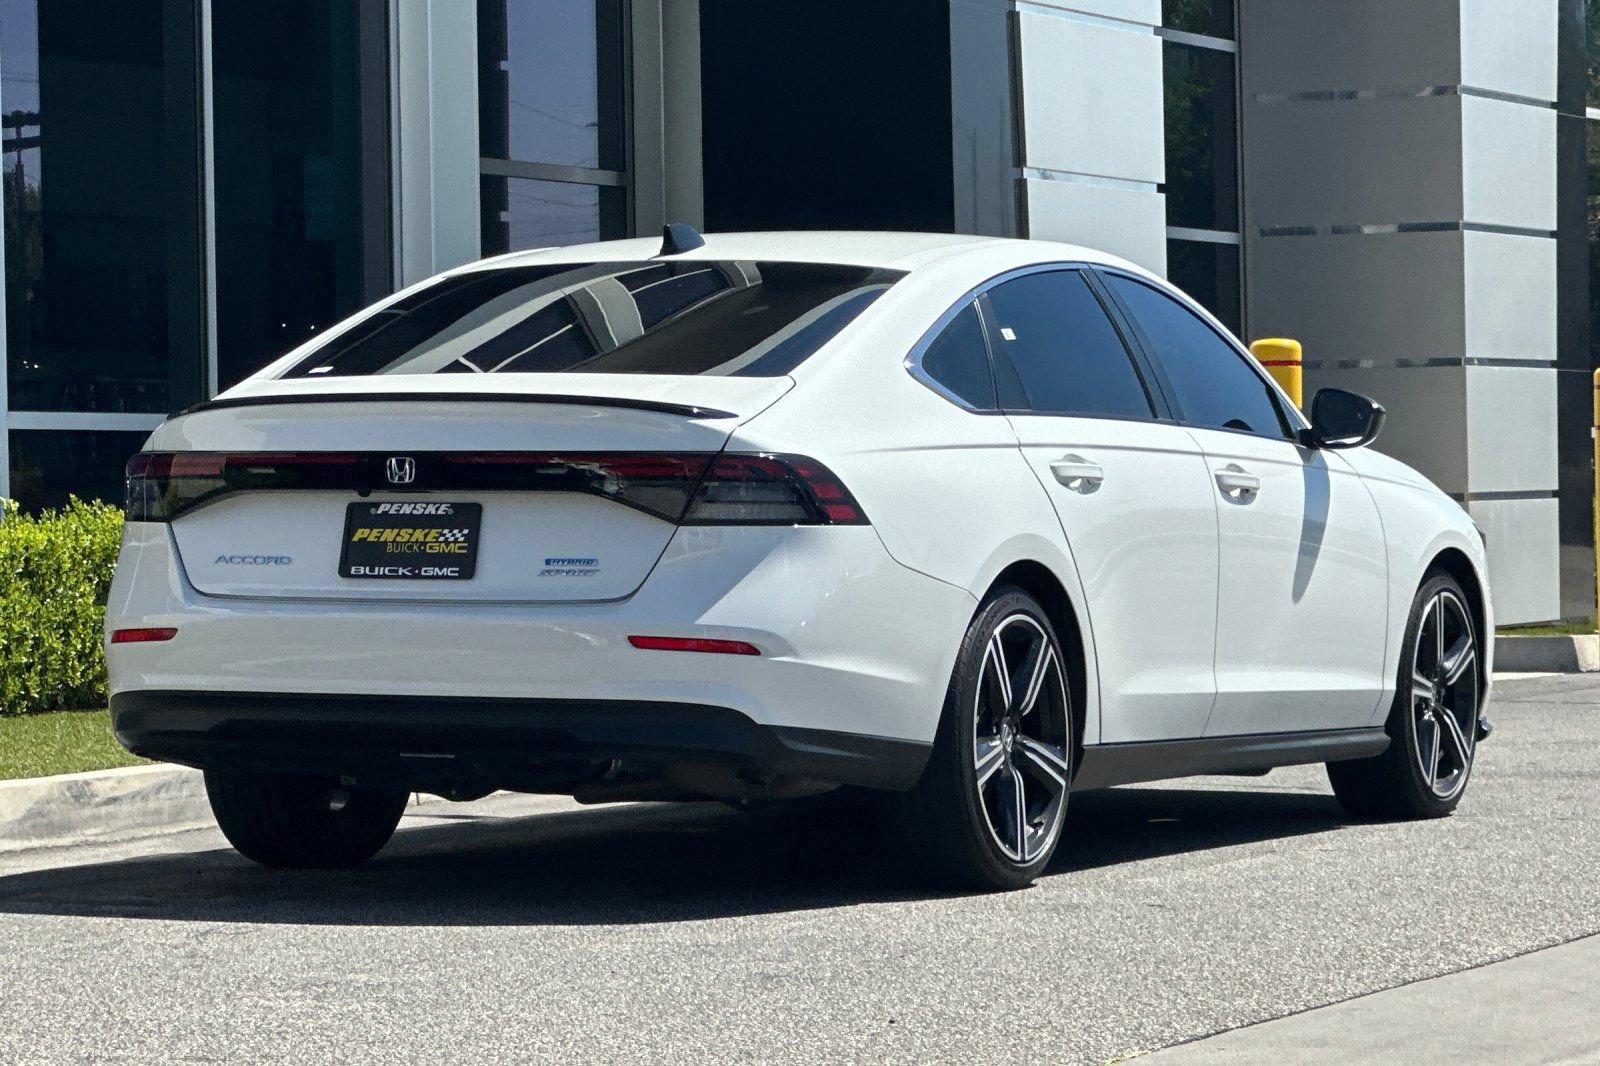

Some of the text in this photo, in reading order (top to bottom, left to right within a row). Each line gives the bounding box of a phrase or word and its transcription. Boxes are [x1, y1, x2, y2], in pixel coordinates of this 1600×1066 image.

[376, 503, 451, 515] PENSKE
[351, 528, 443, 542] PENSKE
[386, 542, 468, 553] BUICK GMC
[214, 555, 292, 566] ACCORD
[350, 566, 459, 576] BUICK GMC
